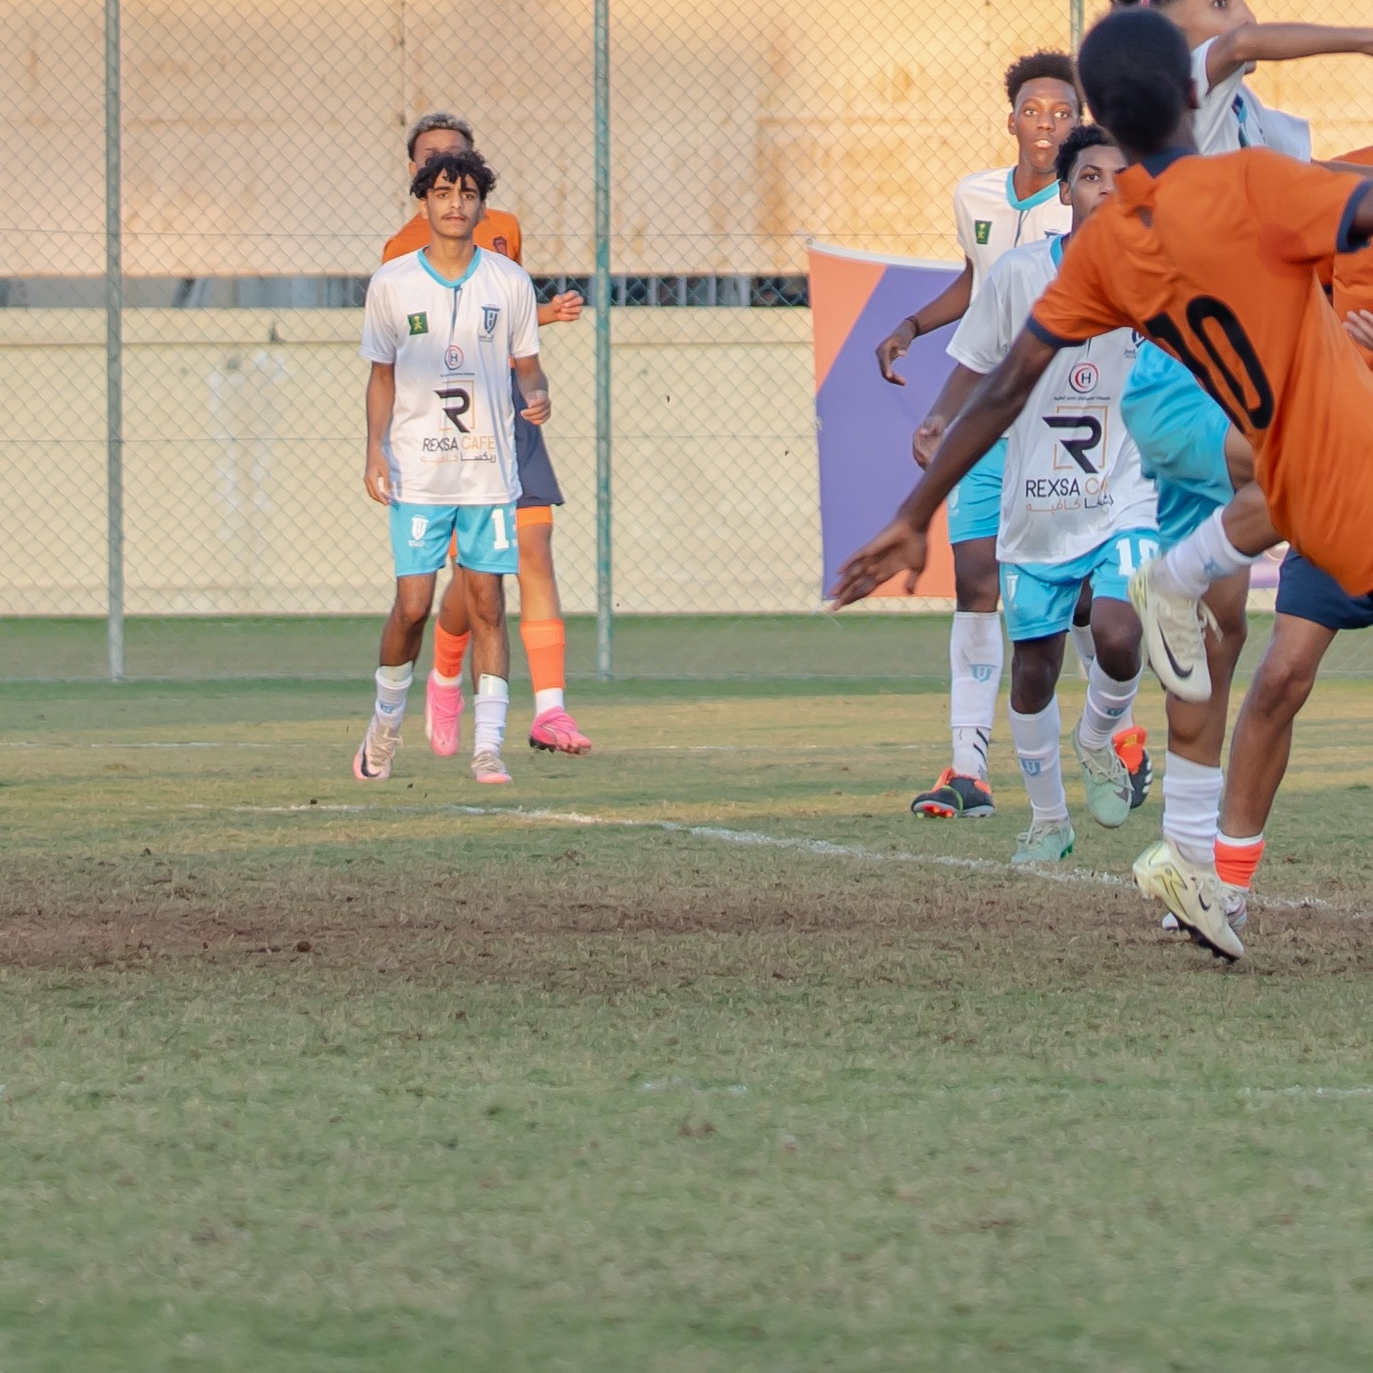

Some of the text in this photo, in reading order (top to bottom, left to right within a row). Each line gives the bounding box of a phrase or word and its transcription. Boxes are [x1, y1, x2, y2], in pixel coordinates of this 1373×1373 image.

[1144, 294, 1274, 435] 10
[422, 435, 495, 452] REXSA CAFE
[1042, 415, 1102, 474] R
[1025, 477, 1081, 498] REXSA
